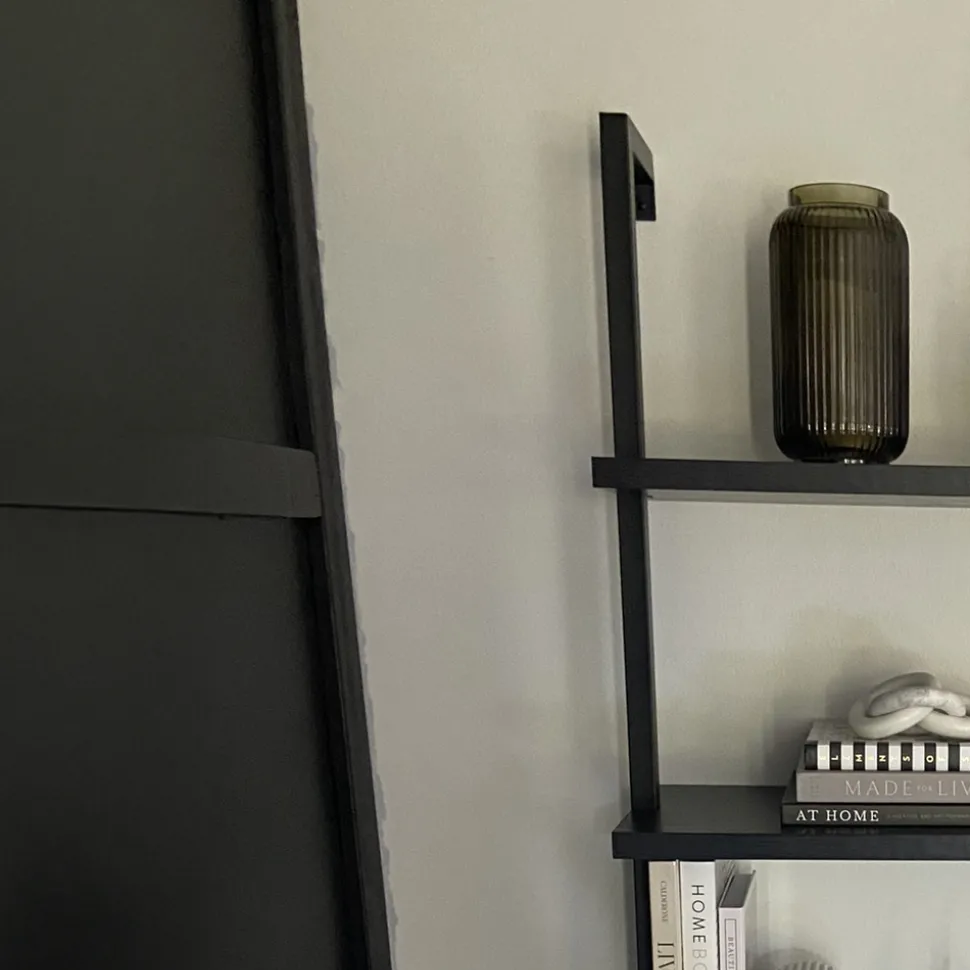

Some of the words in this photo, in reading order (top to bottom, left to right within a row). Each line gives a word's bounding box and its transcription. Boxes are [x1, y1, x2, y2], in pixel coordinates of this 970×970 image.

[845, 780, 913, 796] MADE
[916, 784, 933, 793] FOR
[796, 810, 818, 821] AT
[827, 810, 879, 821] HOME
